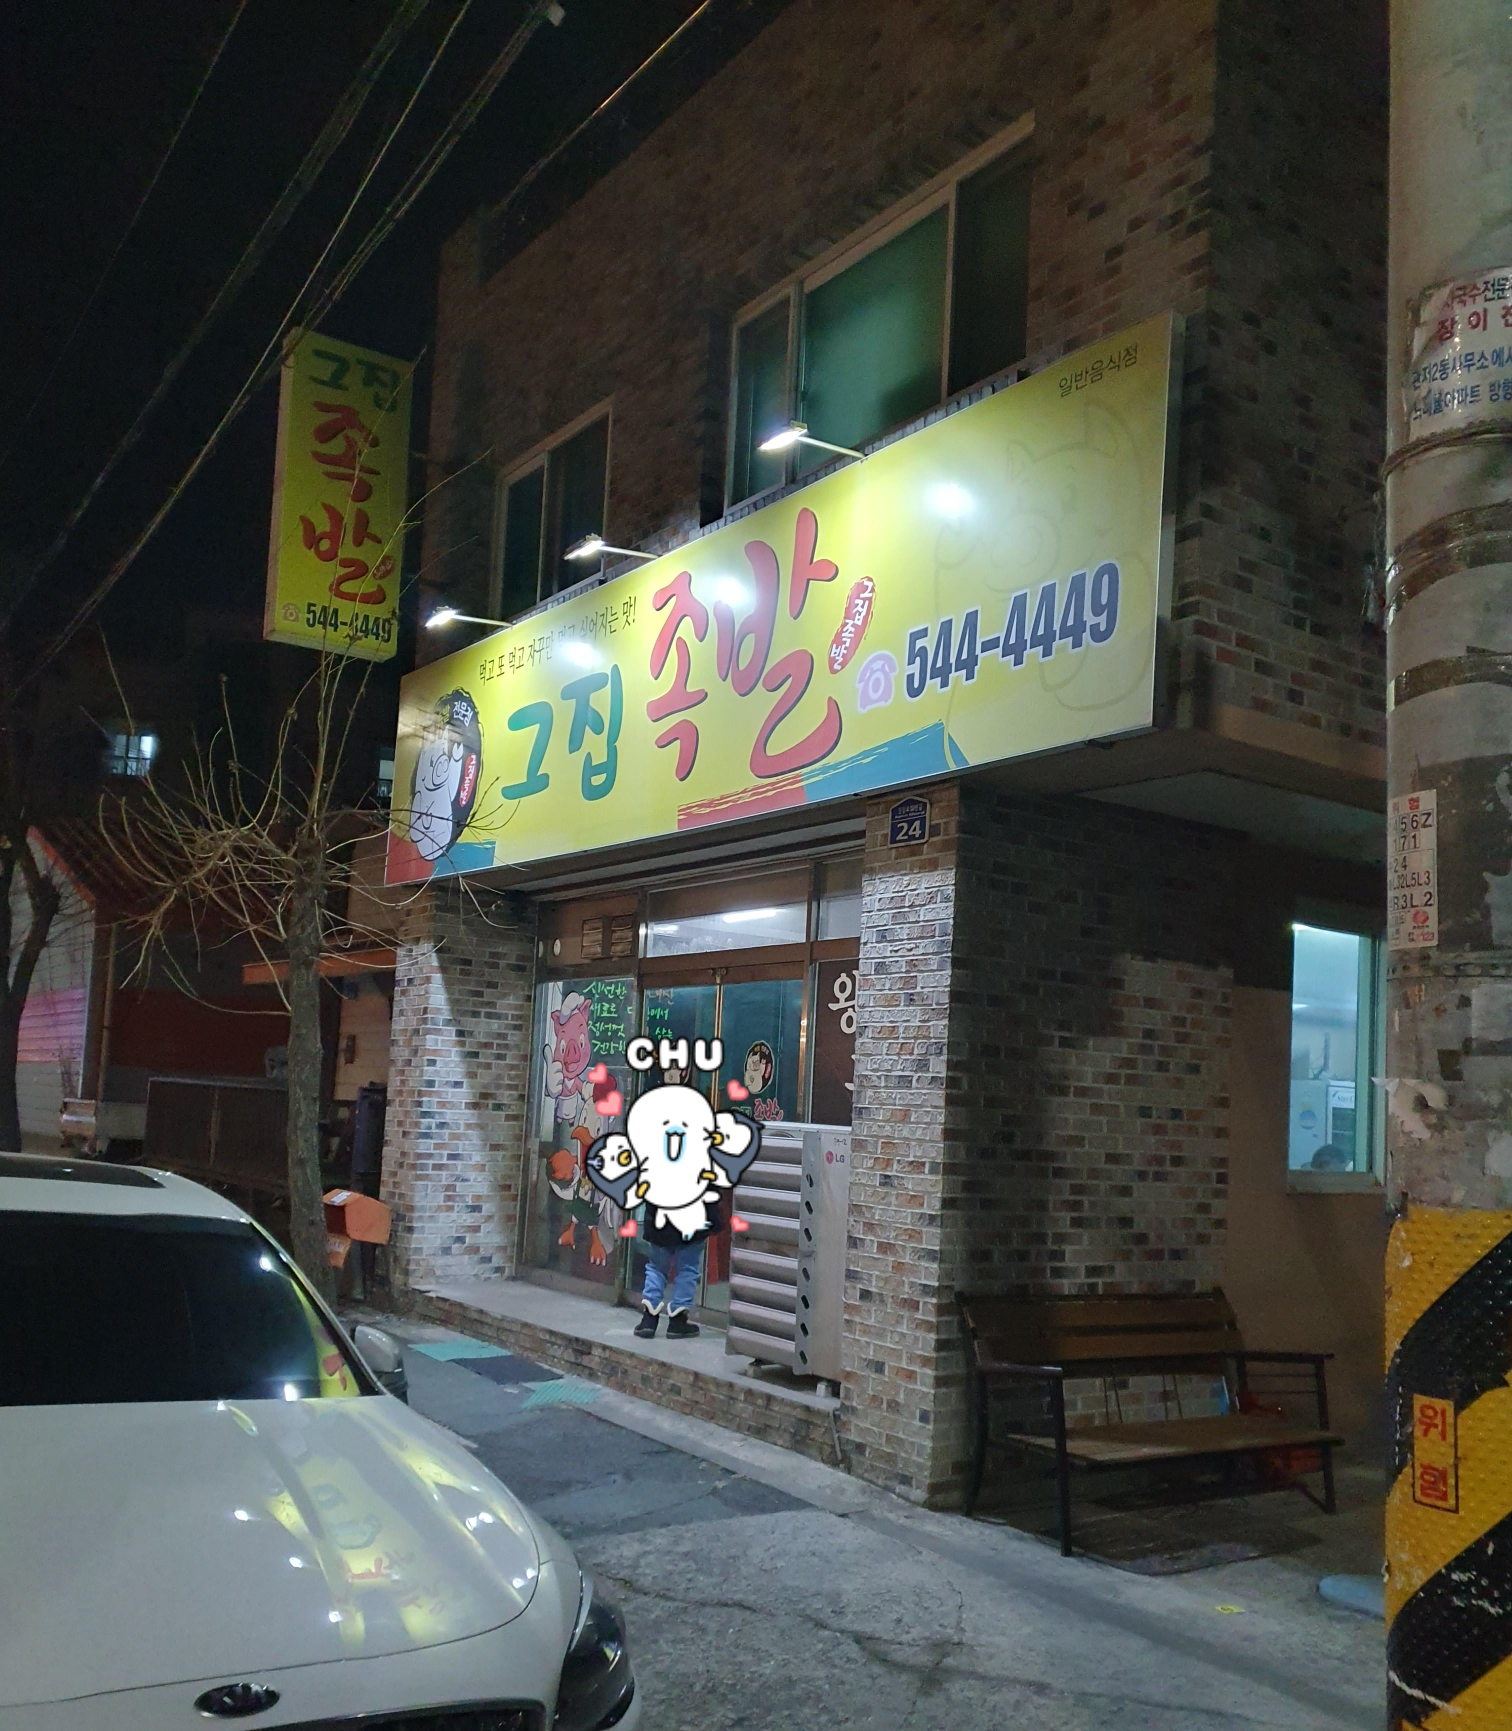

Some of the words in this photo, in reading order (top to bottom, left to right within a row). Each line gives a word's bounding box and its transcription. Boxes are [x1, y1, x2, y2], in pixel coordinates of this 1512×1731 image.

[1058, 343, 1139, 398] 일반음식점
[299, 400, 387, 605] 족발
[830, 580, 874, 671] 그집족발
[906, 561, 1120, 699] 544-4449
[479, 659, 495, 686] 먹고
[496, 654, 505, 677] 또
[527, 630, 555, 667] 자꾸만
[501, 663, 624, 802] 그집
[646, 507, 843, 782] 족발
[453, 700, 474, 727] 전문점
[896, 820, 922, 841] 24
[582, 981, 628, 999] 신선한
[587, 1020, 626, 1038] 정성껏
[835, 1154, 845, 1163] LG
